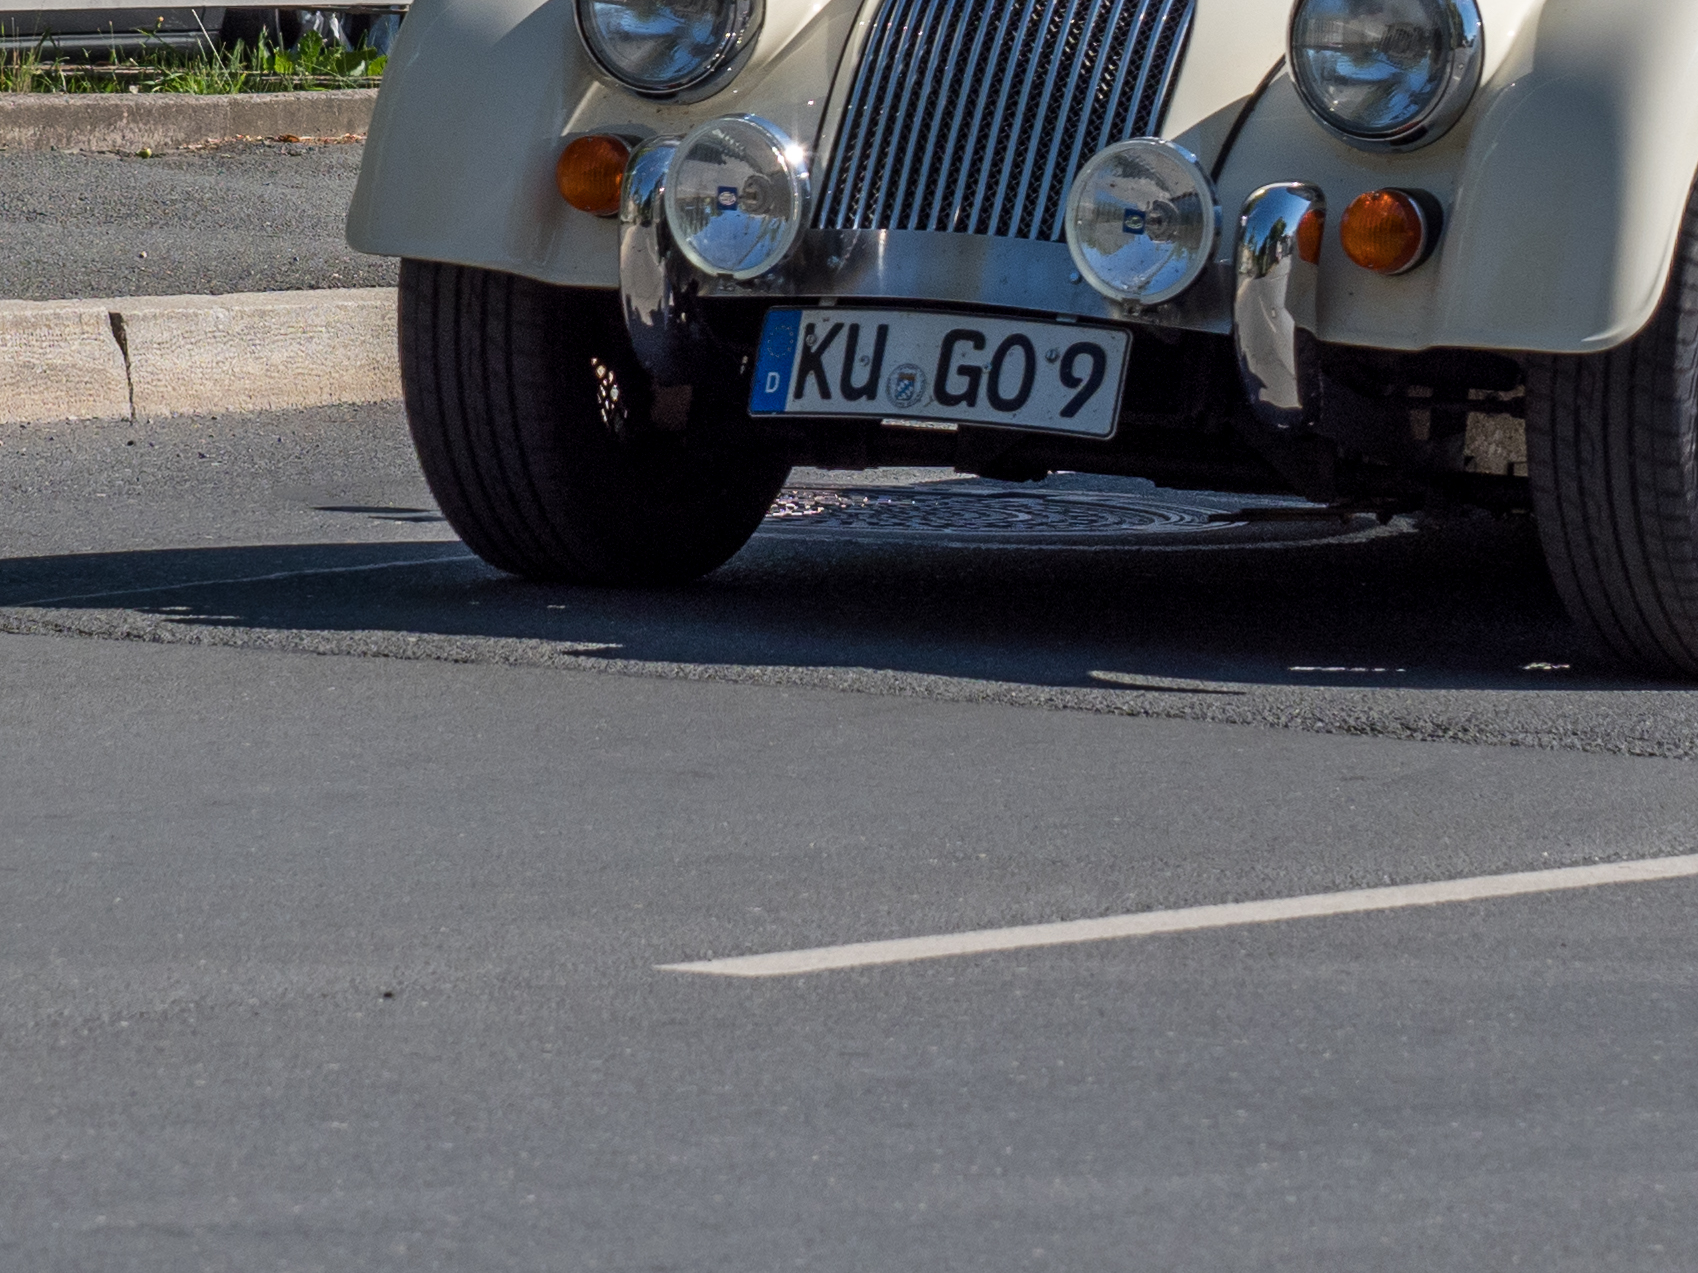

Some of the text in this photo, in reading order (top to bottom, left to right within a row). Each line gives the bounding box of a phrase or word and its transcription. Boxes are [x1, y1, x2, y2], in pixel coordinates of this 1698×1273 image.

[764, 371, 780, 394] D
[793, 322, 1108, 418] KU GO 9
